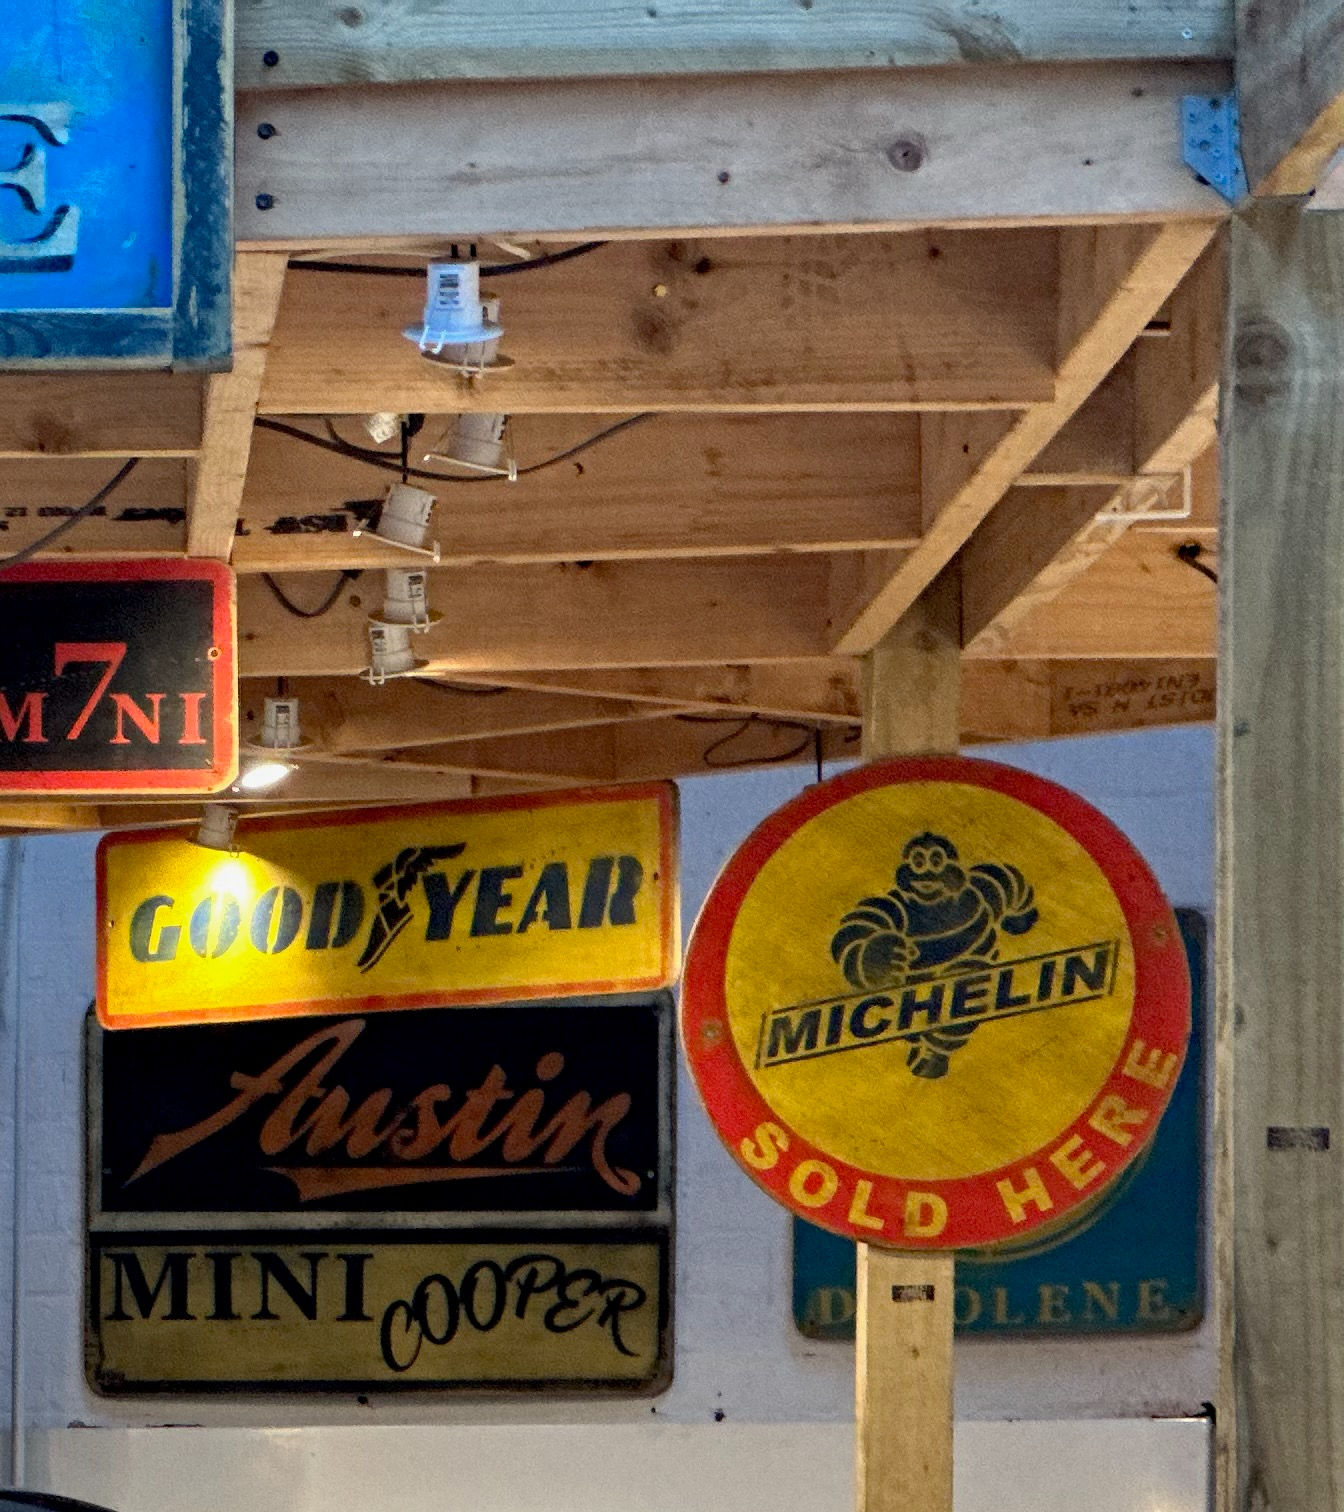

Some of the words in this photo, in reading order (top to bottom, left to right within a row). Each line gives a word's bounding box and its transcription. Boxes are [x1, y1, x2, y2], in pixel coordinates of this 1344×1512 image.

[766, 948, 1108, 1060] MICHELIN
[123, 1018, 642, 1199] Austin
[739, 1121, 949, 1238] SOLD
[995, 1040, 1178, 1224] HERE
[103, 1251, 374, 1322] MINI
[380, 1253, 648, 1374] COOPER
